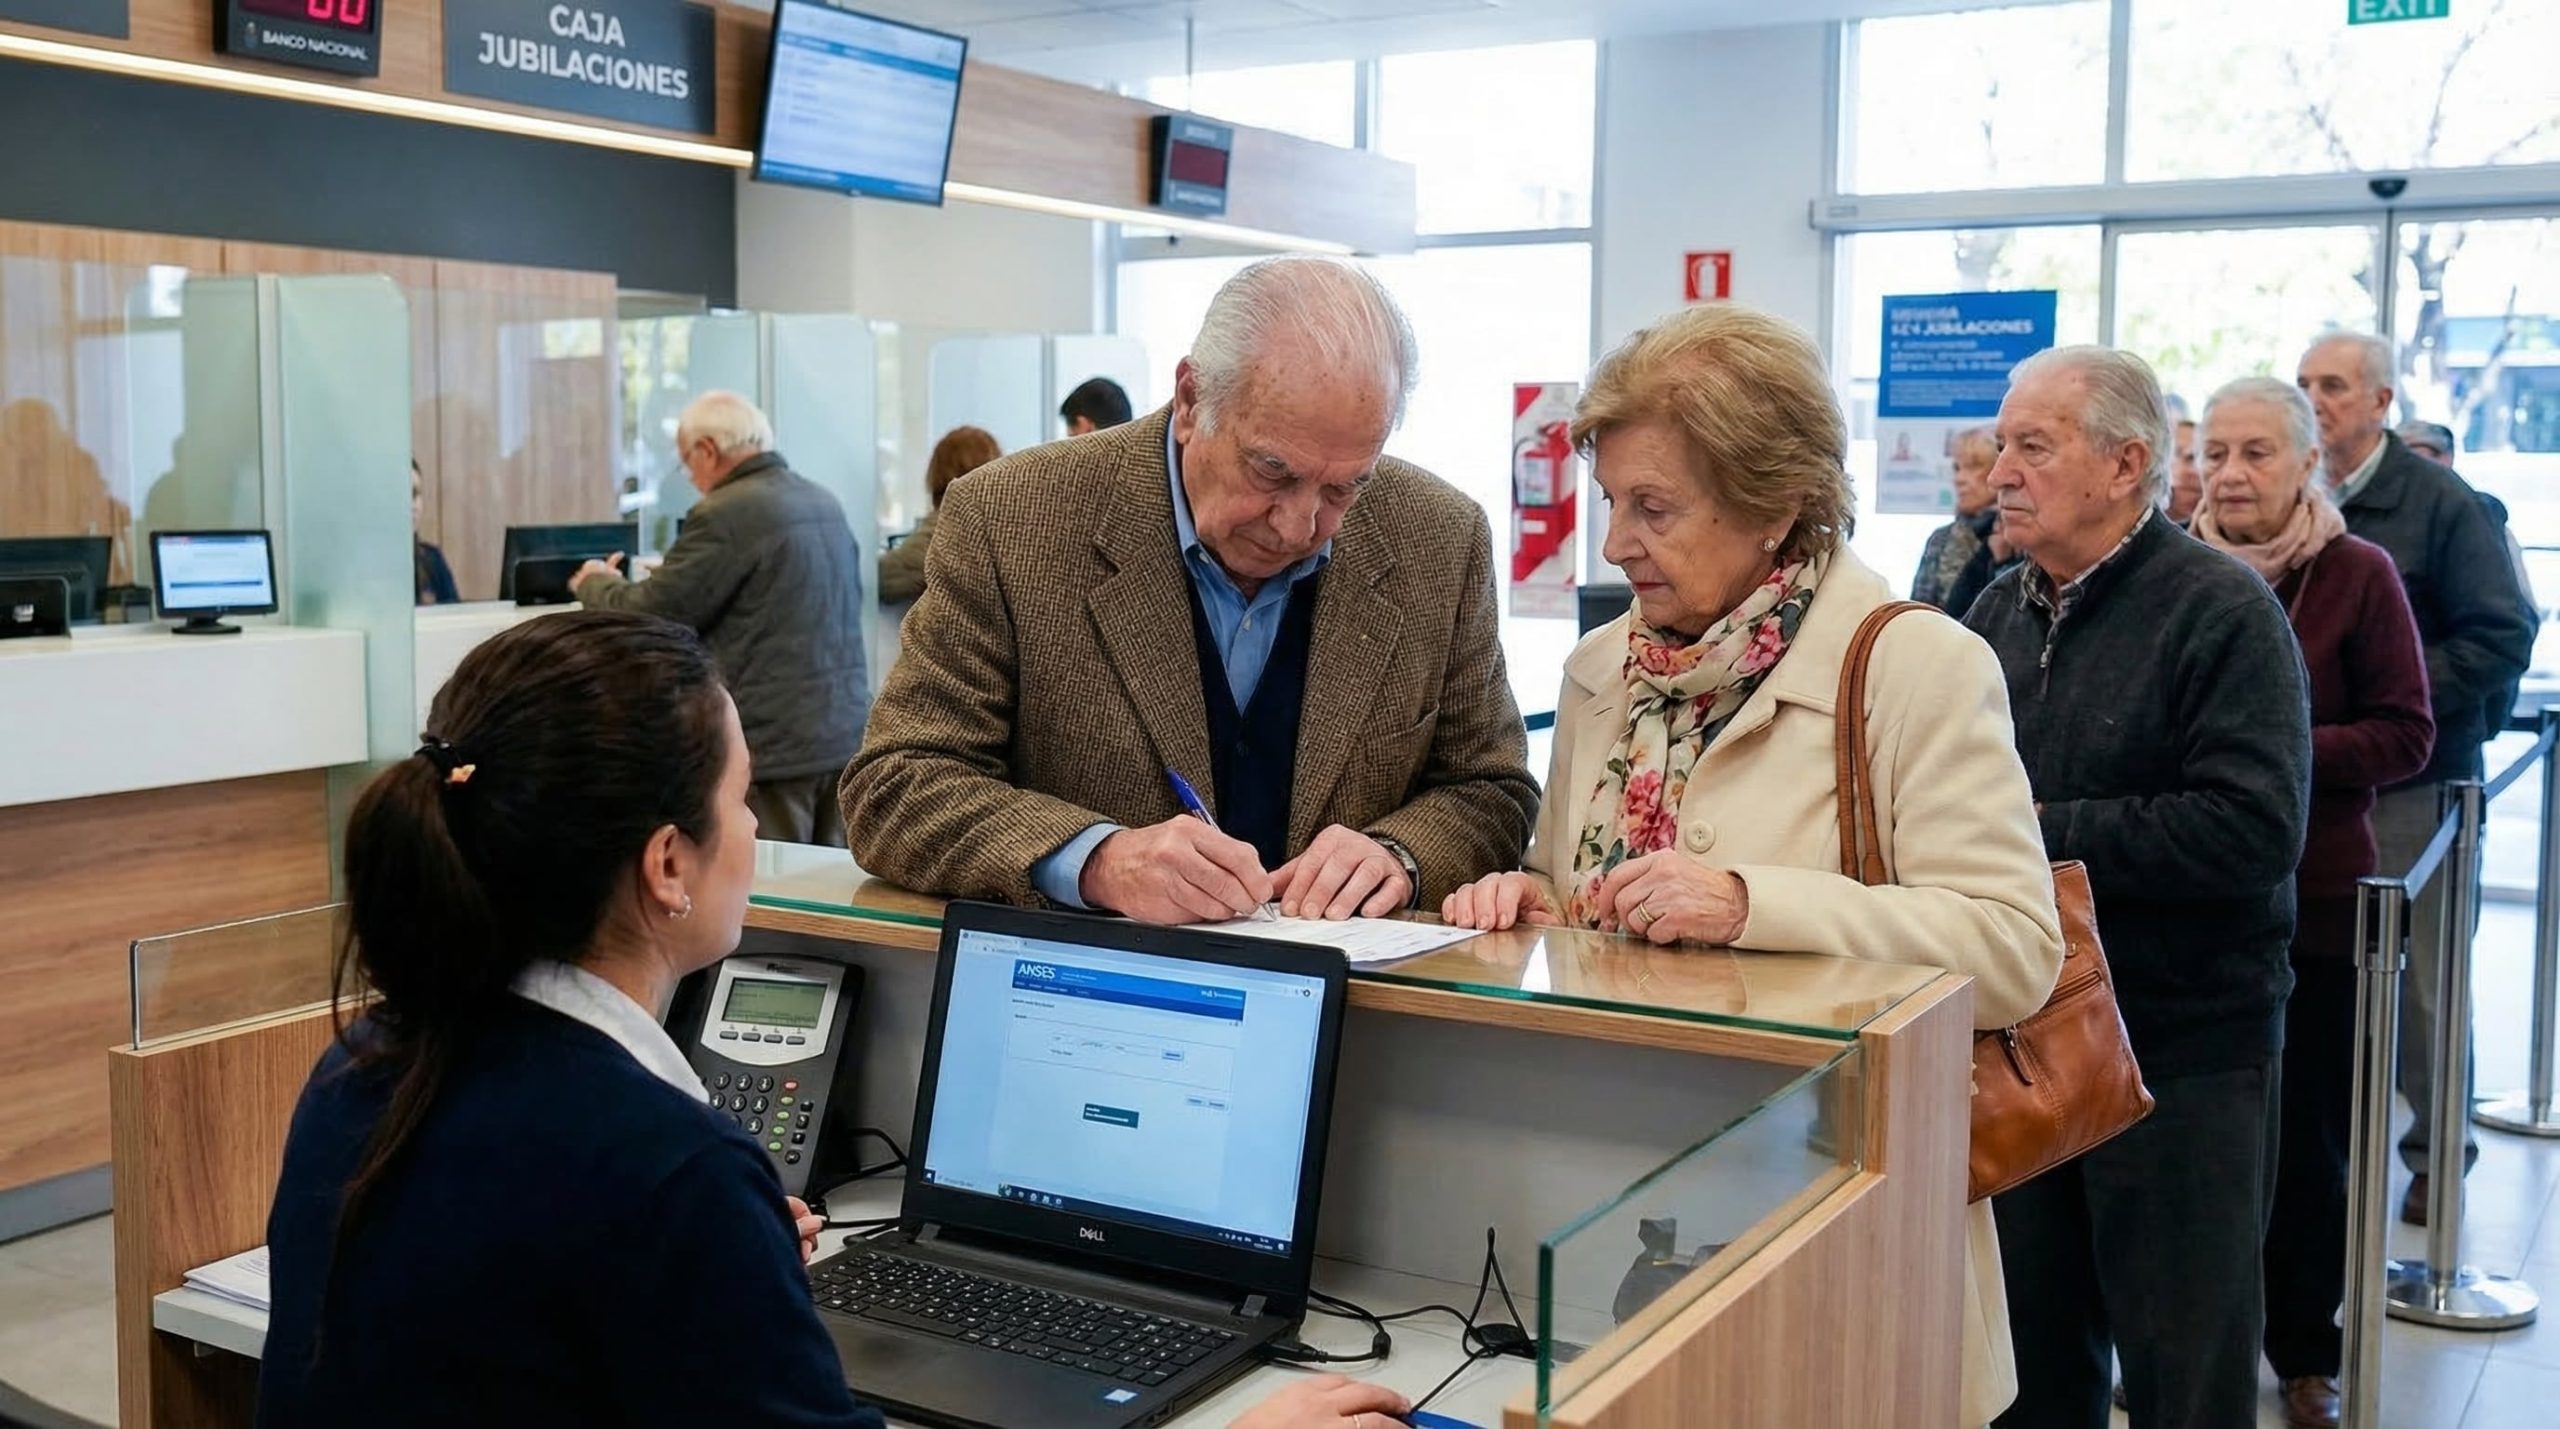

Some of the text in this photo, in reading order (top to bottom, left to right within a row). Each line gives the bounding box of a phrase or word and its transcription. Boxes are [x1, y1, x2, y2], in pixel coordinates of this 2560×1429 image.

[549, 4, 626, 47] CAJA
[262, 30, 369, 60] BANCO NACIONAL
[478, 32, 690, 99] JUBILACIONES
[1017, 963, 1057, 979] ANSES
[1079, 1226, 1105, 1242] DELL
